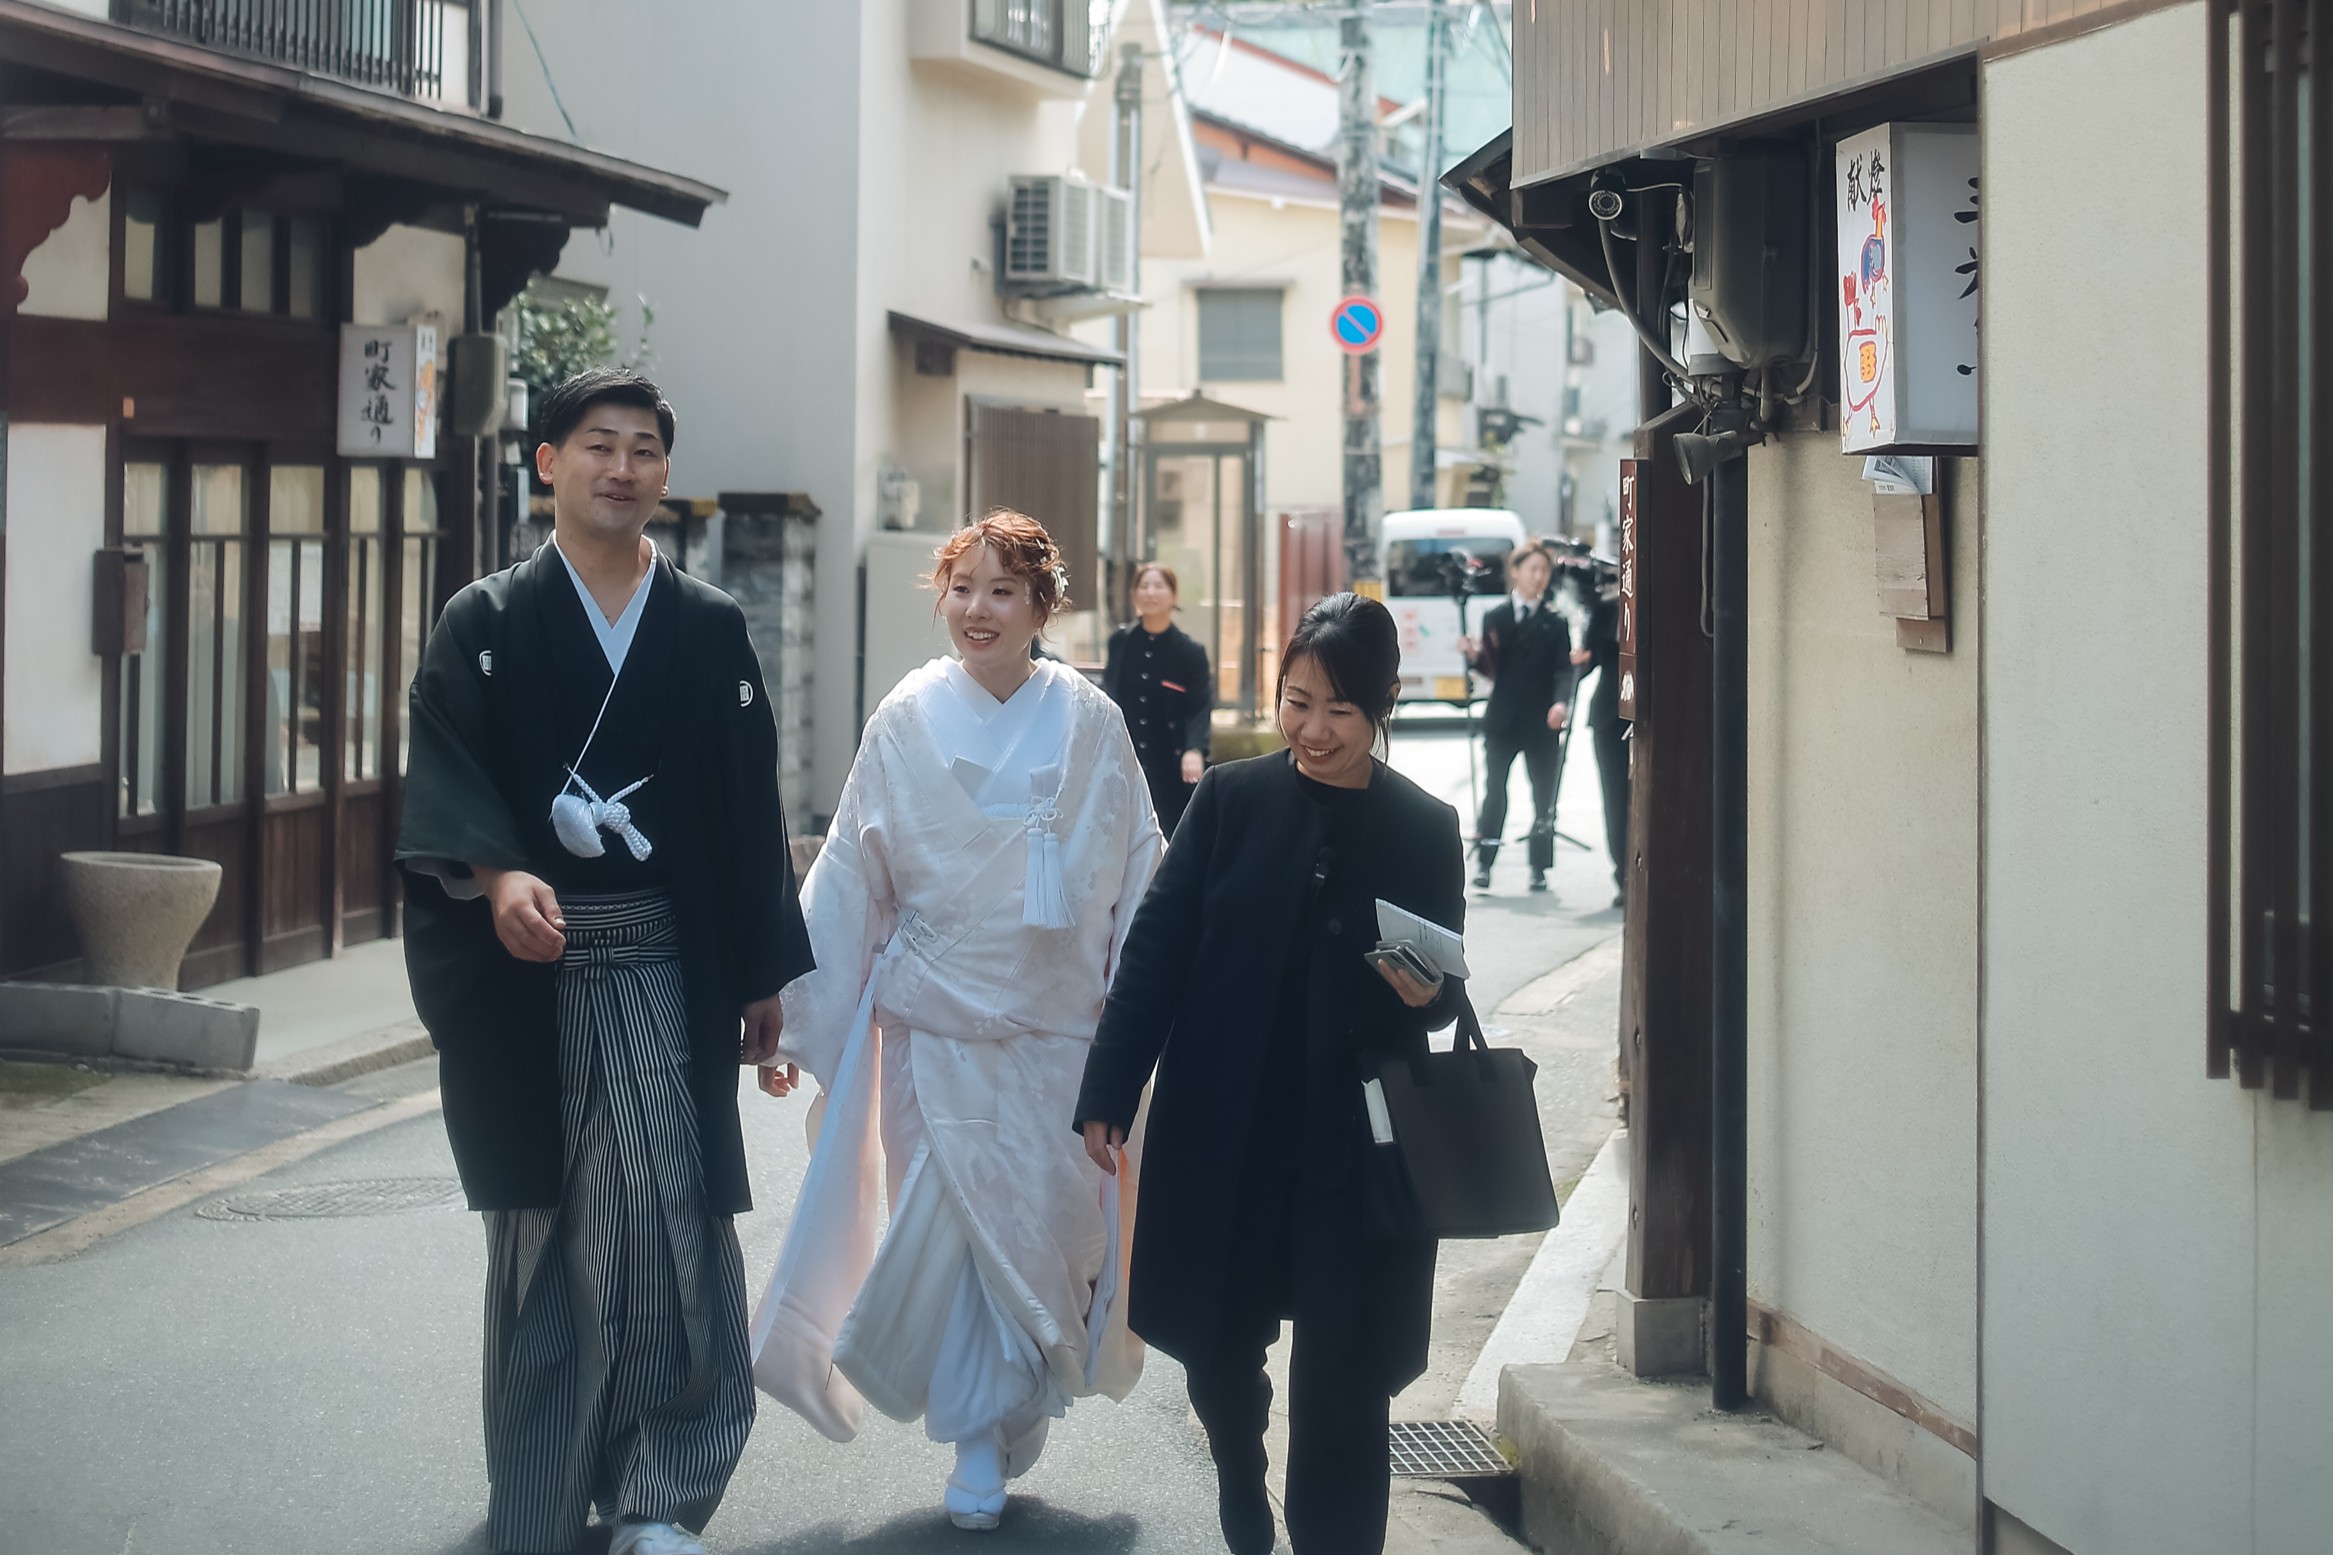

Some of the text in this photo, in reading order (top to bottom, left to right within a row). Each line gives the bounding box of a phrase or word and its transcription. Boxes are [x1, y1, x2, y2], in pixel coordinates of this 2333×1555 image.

[360, 339, 397, 443] 町家通り
[1621, 476, 1635, 642] 町家通り
